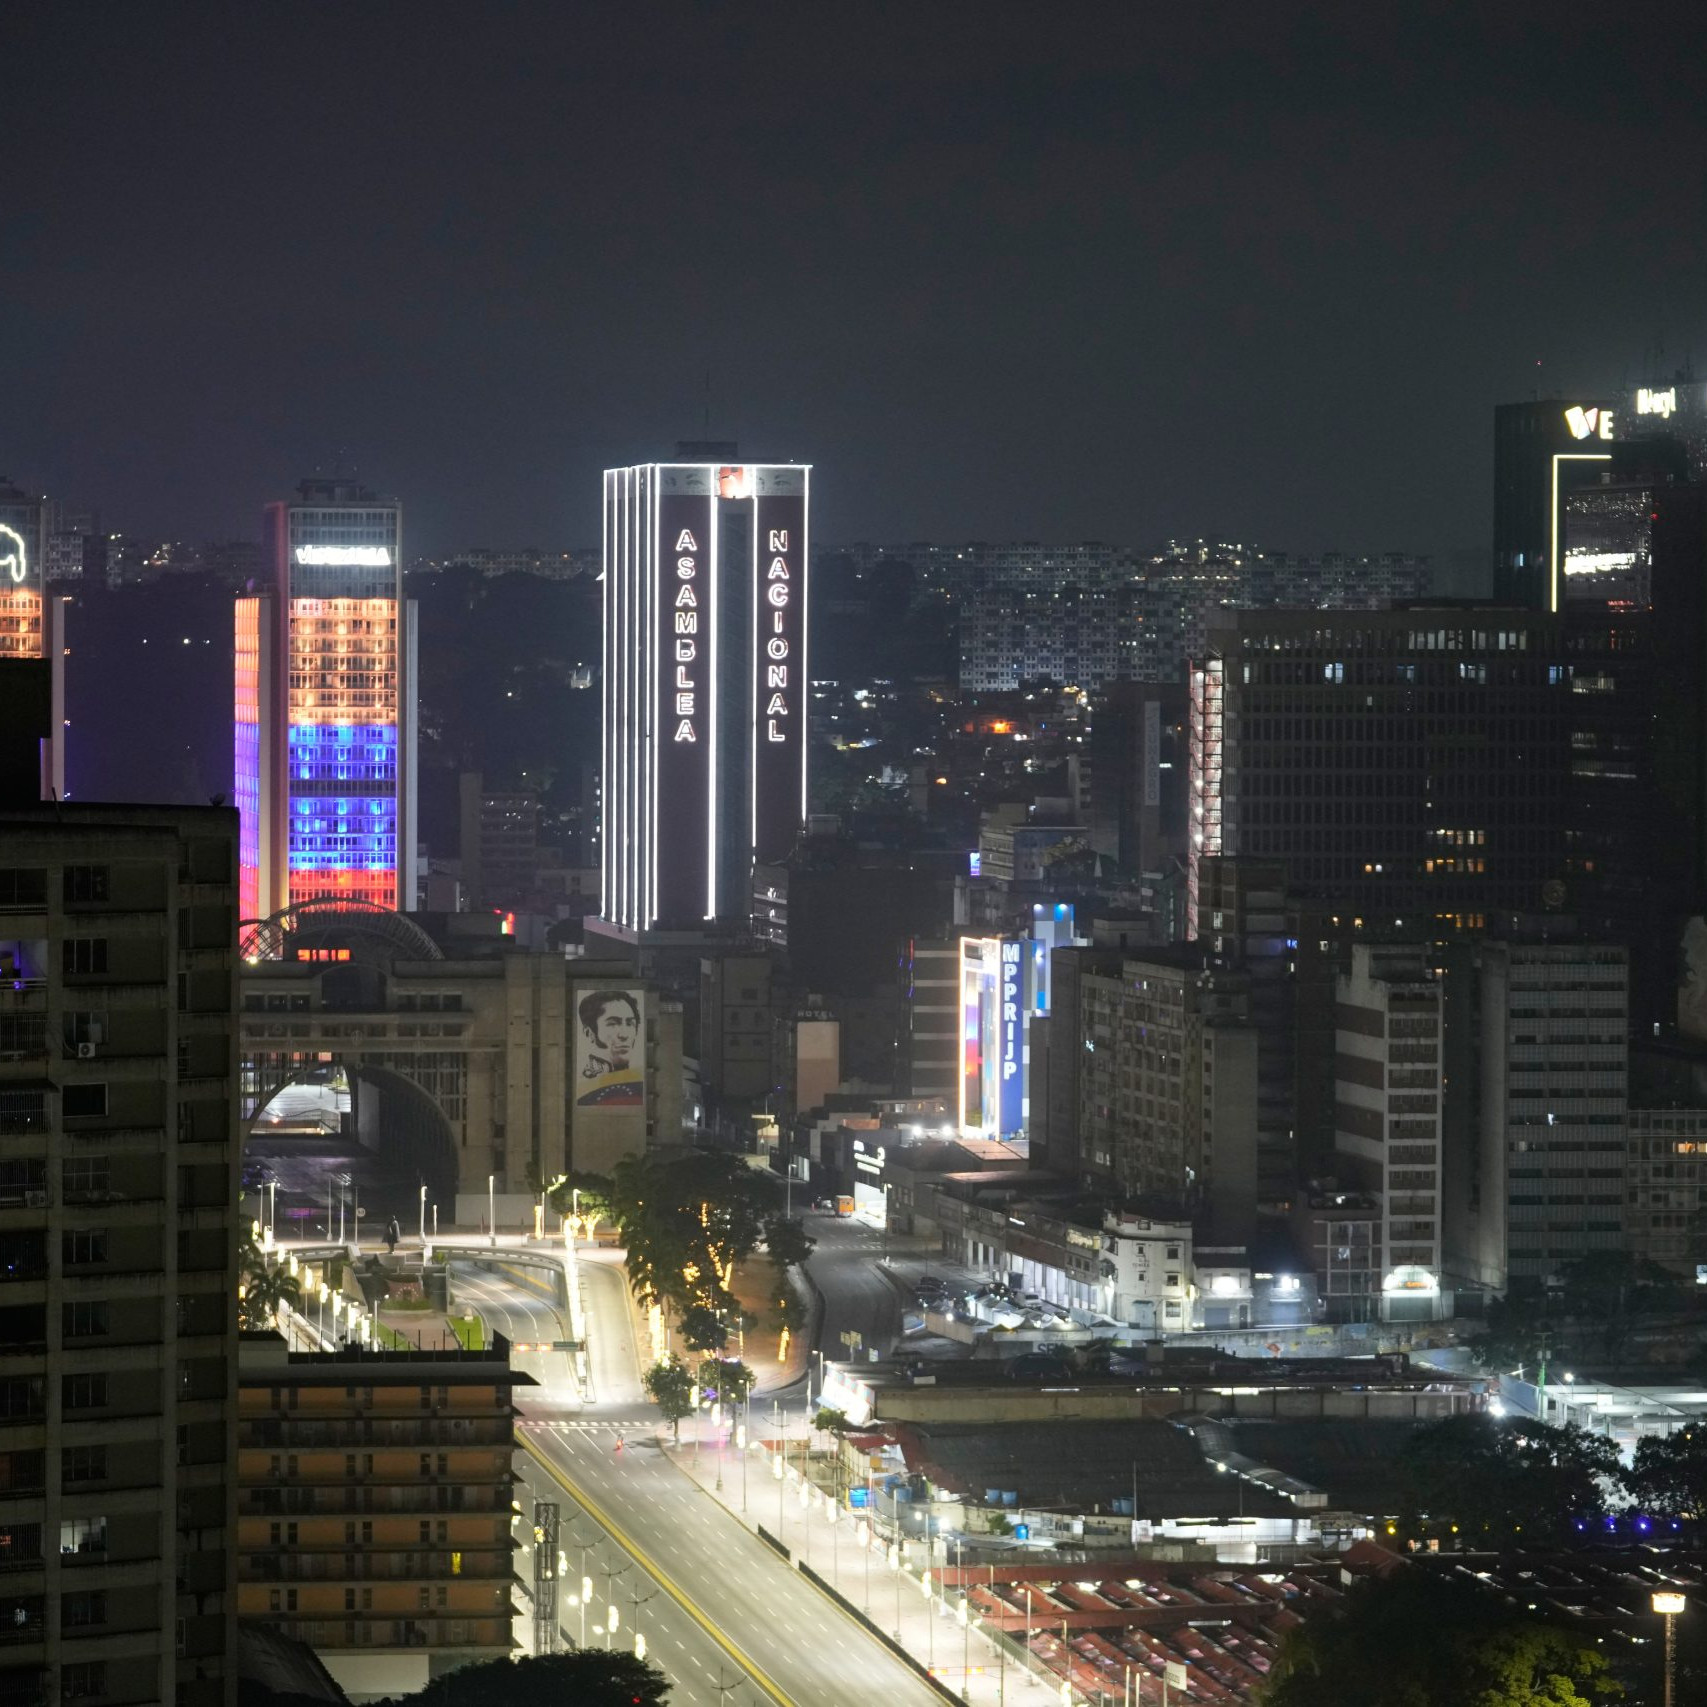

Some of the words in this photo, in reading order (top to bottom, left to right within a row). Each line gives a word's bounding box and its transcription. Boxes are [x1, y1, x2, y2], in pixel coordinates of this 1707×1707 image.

[674, 528, 697, 742] ASAMBLEA
[766, 529, 789, 742] NACIONAL
[1002, 943, 1020, 1081] MPPRIJP
